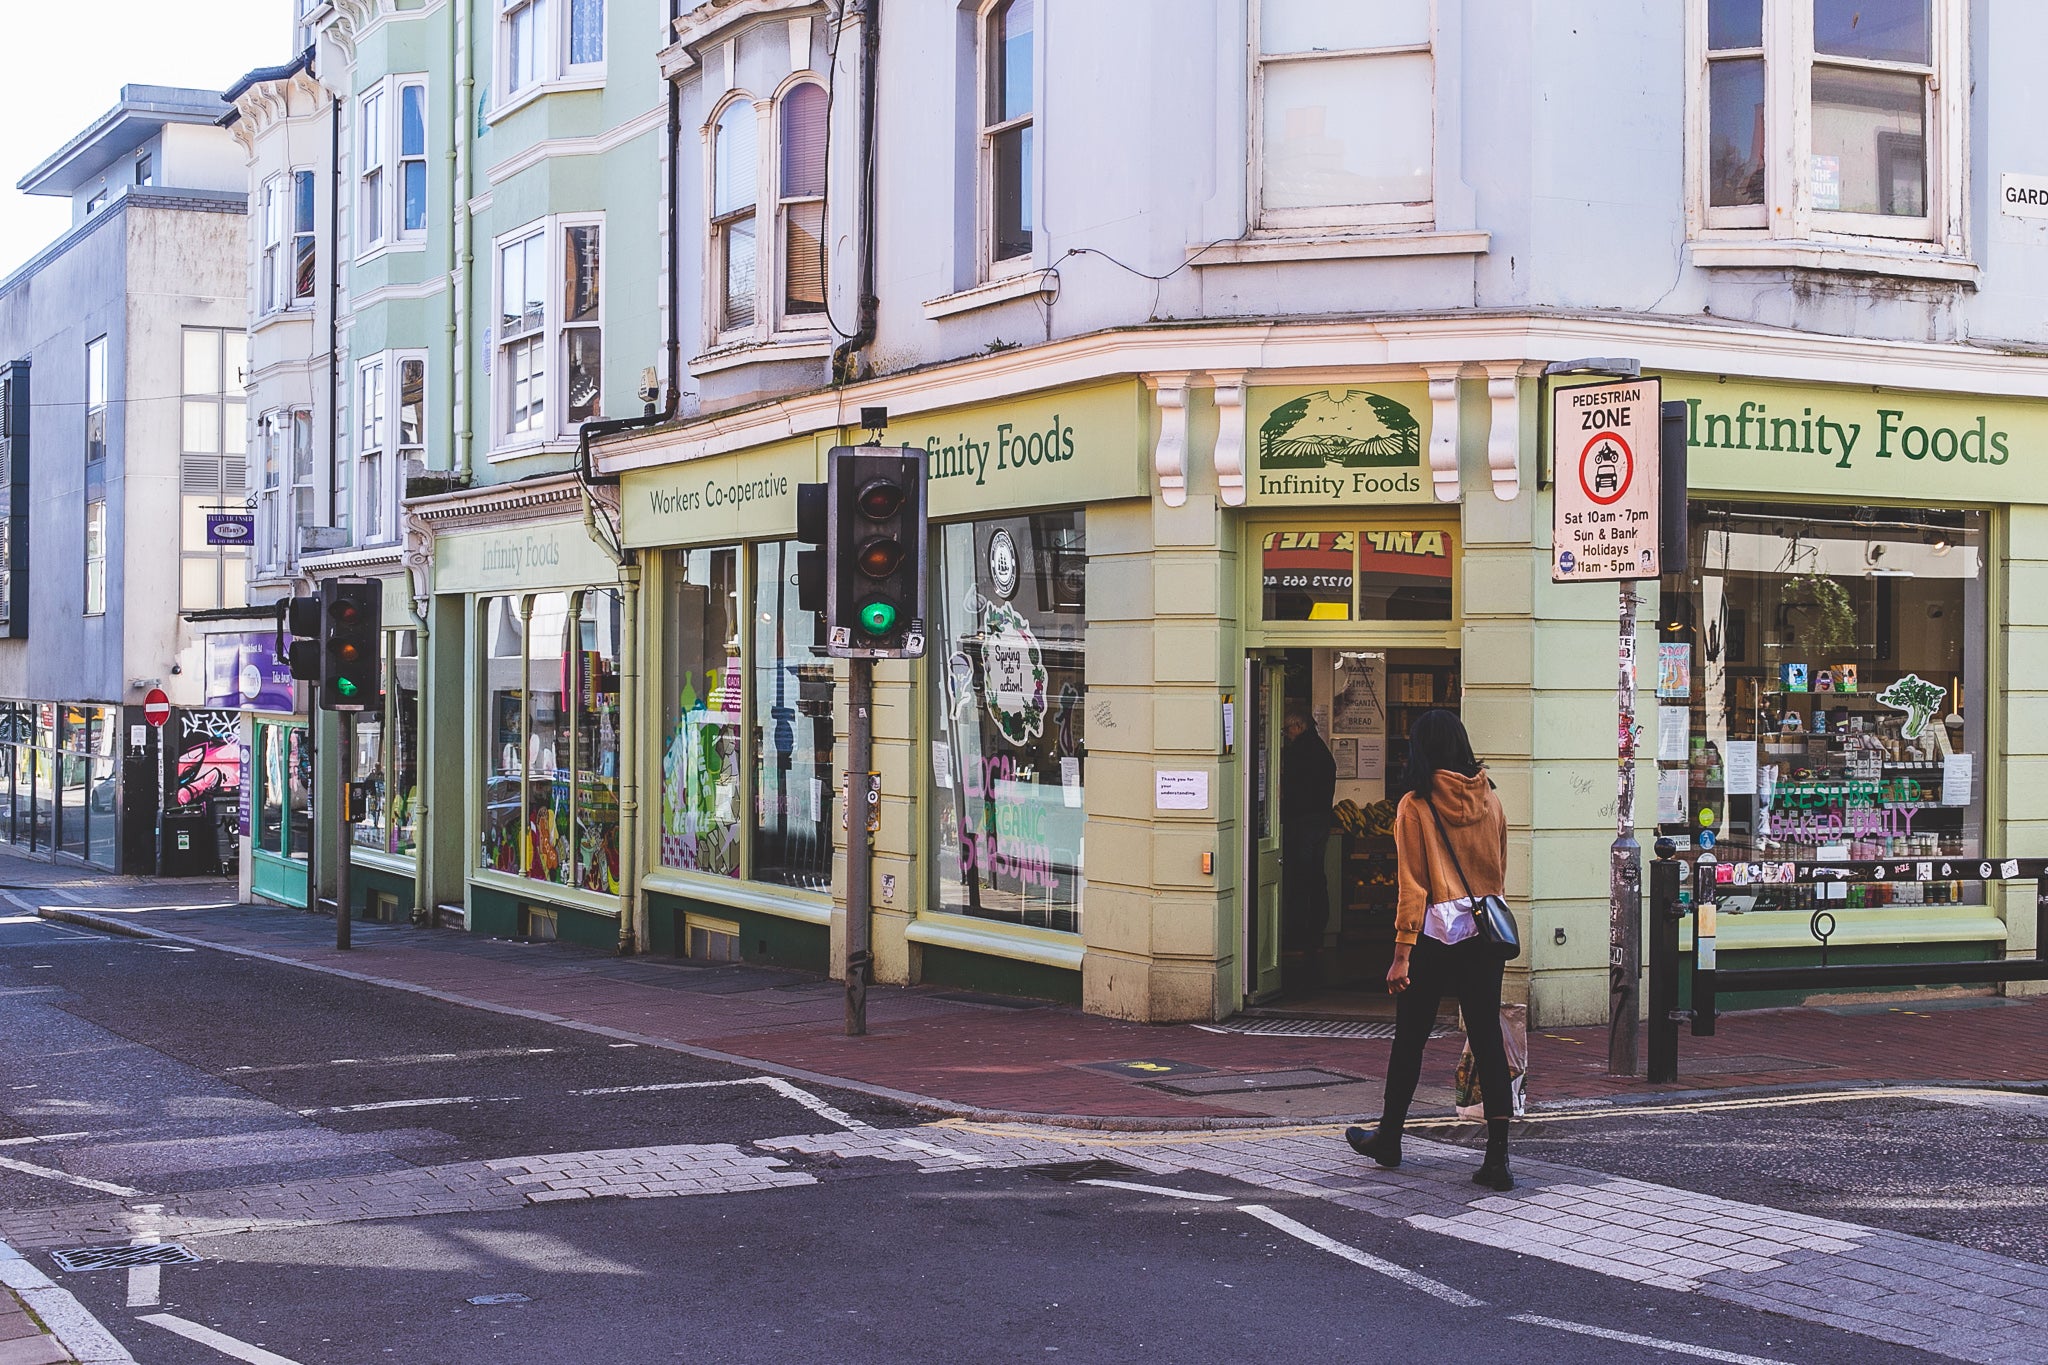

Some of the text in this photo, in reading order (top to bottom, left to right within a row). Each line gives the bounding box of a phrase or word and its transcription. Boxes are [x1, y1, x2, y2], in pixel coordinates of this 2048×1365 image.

[2005, 186, 2048, 205] GARD
[1572, 388, 1640, 407] PEDESTRIAN
[1581, 407, 1631, 430] ZONE
[1686, 398, 2009, 469] Infinity Foods
[902, 414, 1074, 485] finity Foods
[650, 472, 788, 515] Workers Co-operative
[1259, 472, 1420, 498] Infinity Foods
[1564, 512, 1582, 524] Sat
[1587, 511, 1616, 523] 10am
[1625, 509, 1649, 523] 7pm
[1573, 526, 1639, 541] Sun & Bank
[482, 532, 560, 576] Infinity Foods
[1582, 544, 1629, 557] Holidays
[1577, 561, 1601, 573] 11am
[1611, 560, 1635, 573] 5pm
[994, 644, 1021, 670] Spring
[1003, 666, 1015, 674] into
[999, 672, 1023, 693] action!
[1346, 680, 1375, 688] SIMPLY
[1348, 717, 1372, 725] BREAD
[963, 753, 1025, 804] LOCAL
[1769, 782, 1843, 811] FRESH
[1849, 778, 1922, 807] BREAD
[1770, 806, 1919, 843] BAKED DAILY
[957, 815, 1060, 889] SEASONAL
